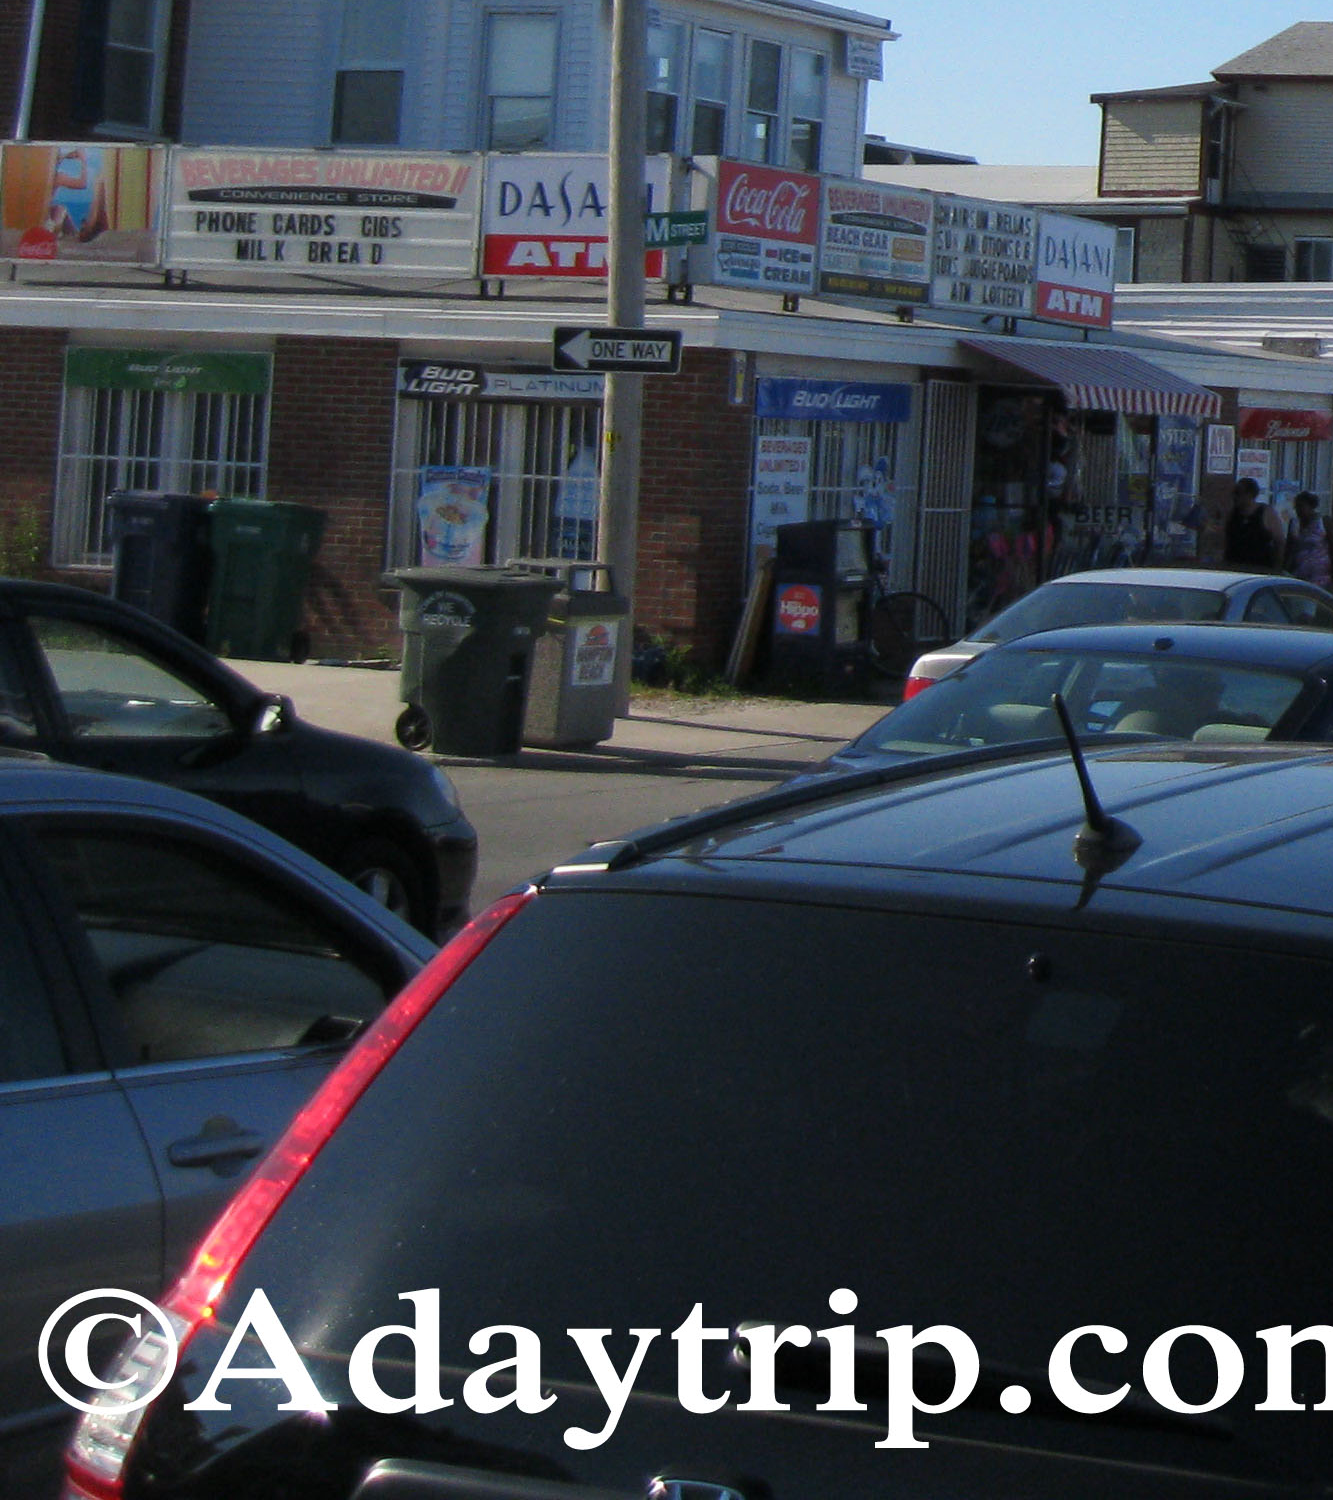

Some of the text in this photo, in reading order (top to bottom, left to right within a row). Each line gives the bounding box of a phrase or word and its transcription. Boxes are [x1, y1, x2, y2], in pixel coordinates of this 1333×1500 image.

[180, 156, 320, 189] BEVERAGES
[323, 160, 451, 192] UNLIMITED
[220, 189, 418, 204] CONVENIENCE STORE
[726, 173, 811, 235] Coca-Cola
[195, 211, 402, 238] PHONE CARDS CIGS
[647, 217, 707, 242] M STREET
[826, 226, 861, 246] BEACH
[861, 233, 889, 250] GEAR
[779, 248, 800, 263] ICE
[1045, 232, 1111, 278] DASANI
[764, 266, 811, 286] CREAM
[1047, 288, 1103, 318] ATM
[592, 341, 667, 359] ONE WAY
[128, 363, 203, 374] BUD LIGHT
[421, 365, 476, 380] BUD
[407, 381, 480, 396] LIGHT
[792, 390, 881, 409] BUD LIGHT
[1075, 506, 1132, 523] BEER
[423, 614, 471, 628] RECYCLE
